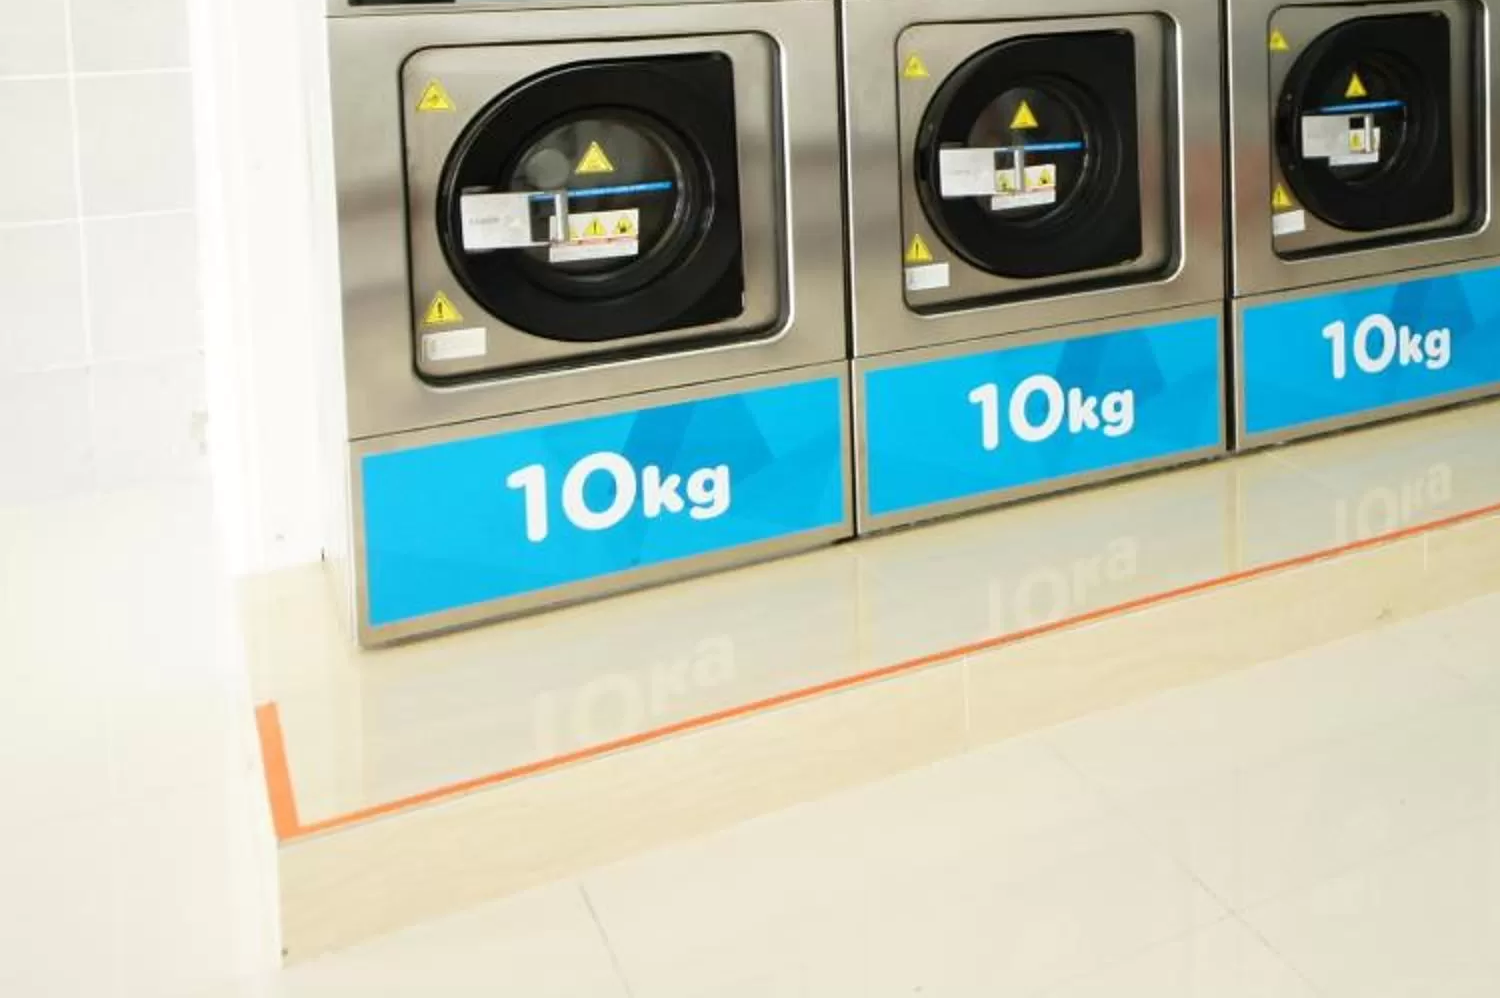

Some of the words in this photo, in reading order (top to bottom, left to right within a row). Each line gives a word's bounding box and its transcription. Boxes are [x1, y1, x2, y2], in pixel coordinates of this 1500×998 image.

[1321, 313, 1451, 379] 10kg
[968, 373, 1135, 451] 10kg
[506, 451, 730, 542] 10kg
